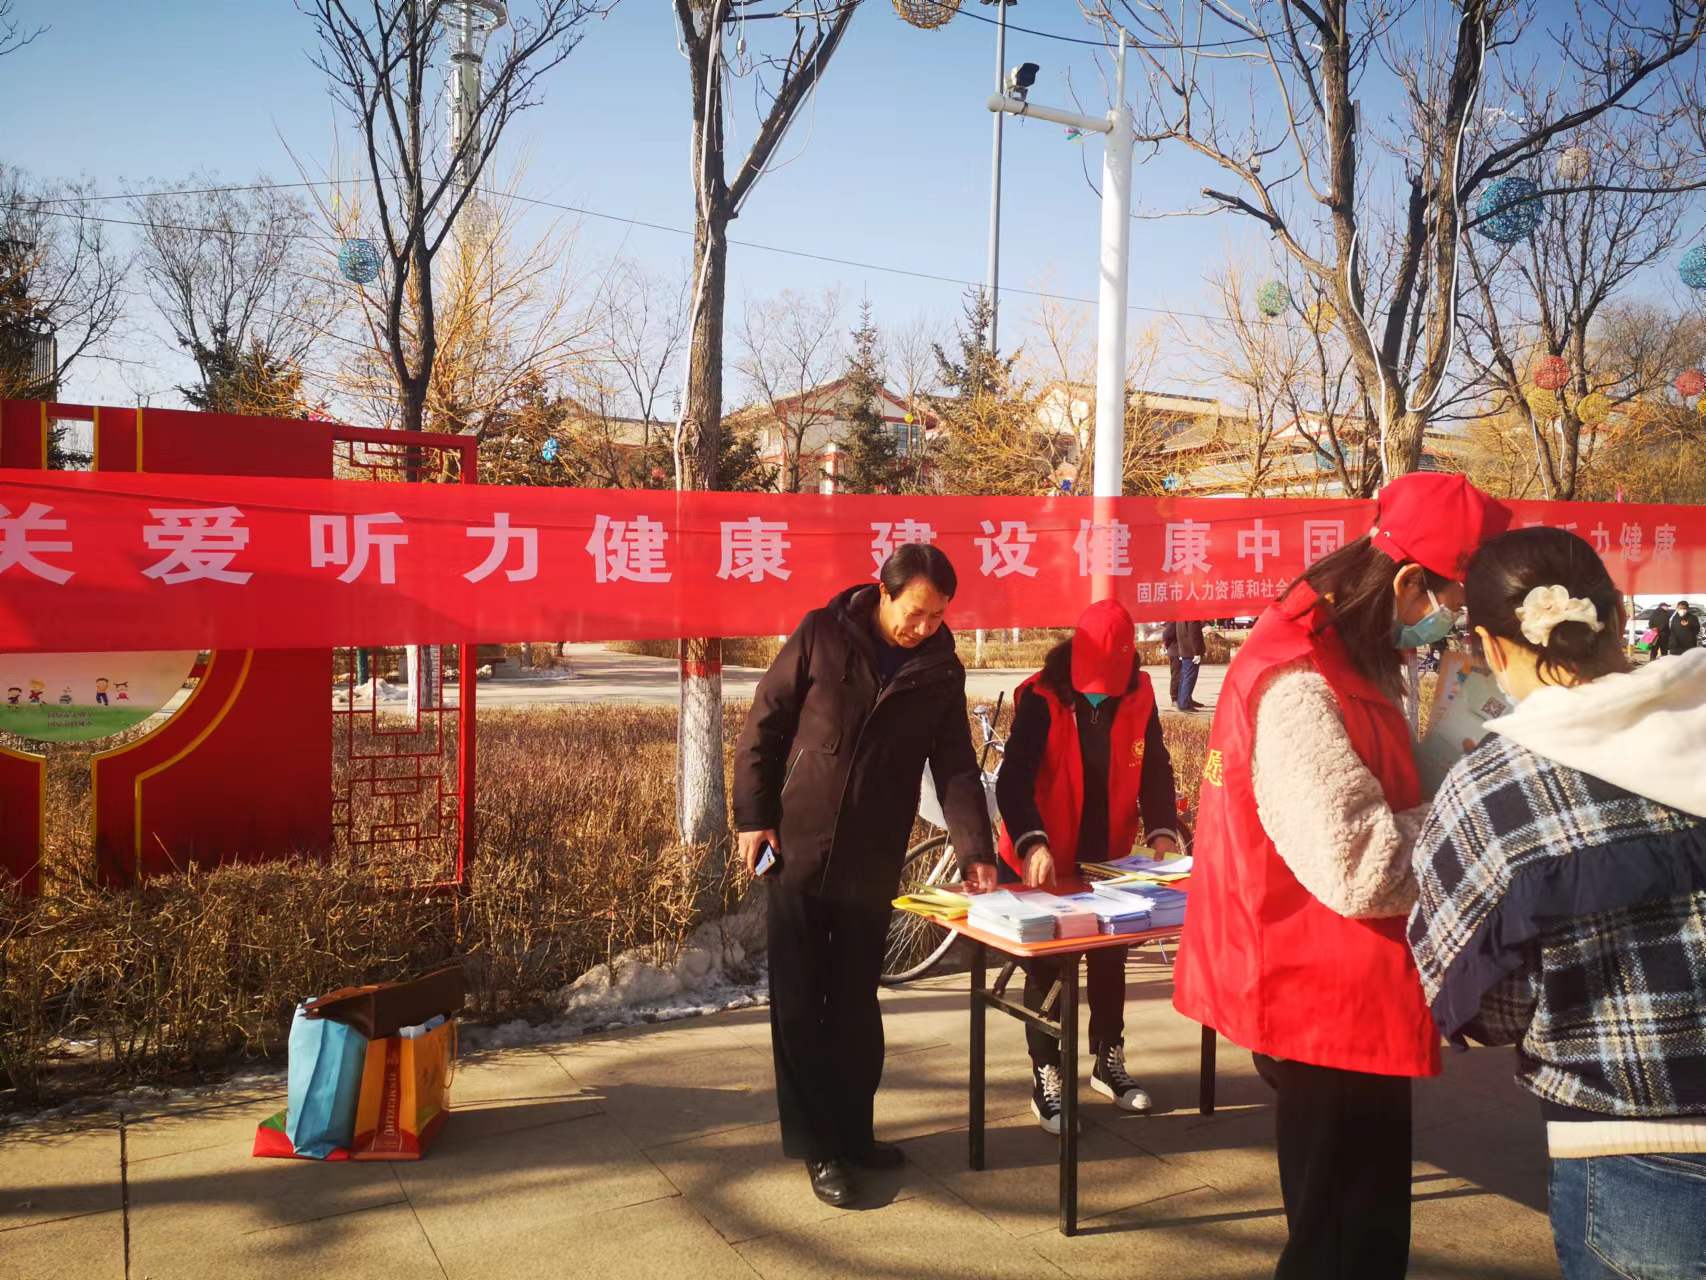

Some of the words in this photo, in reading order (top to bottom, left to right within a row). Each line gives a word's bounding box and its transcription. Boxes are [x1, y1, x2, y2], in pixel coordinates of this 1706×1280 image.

[1137, 577, 1296, 603] 固原市人力资源和社会
